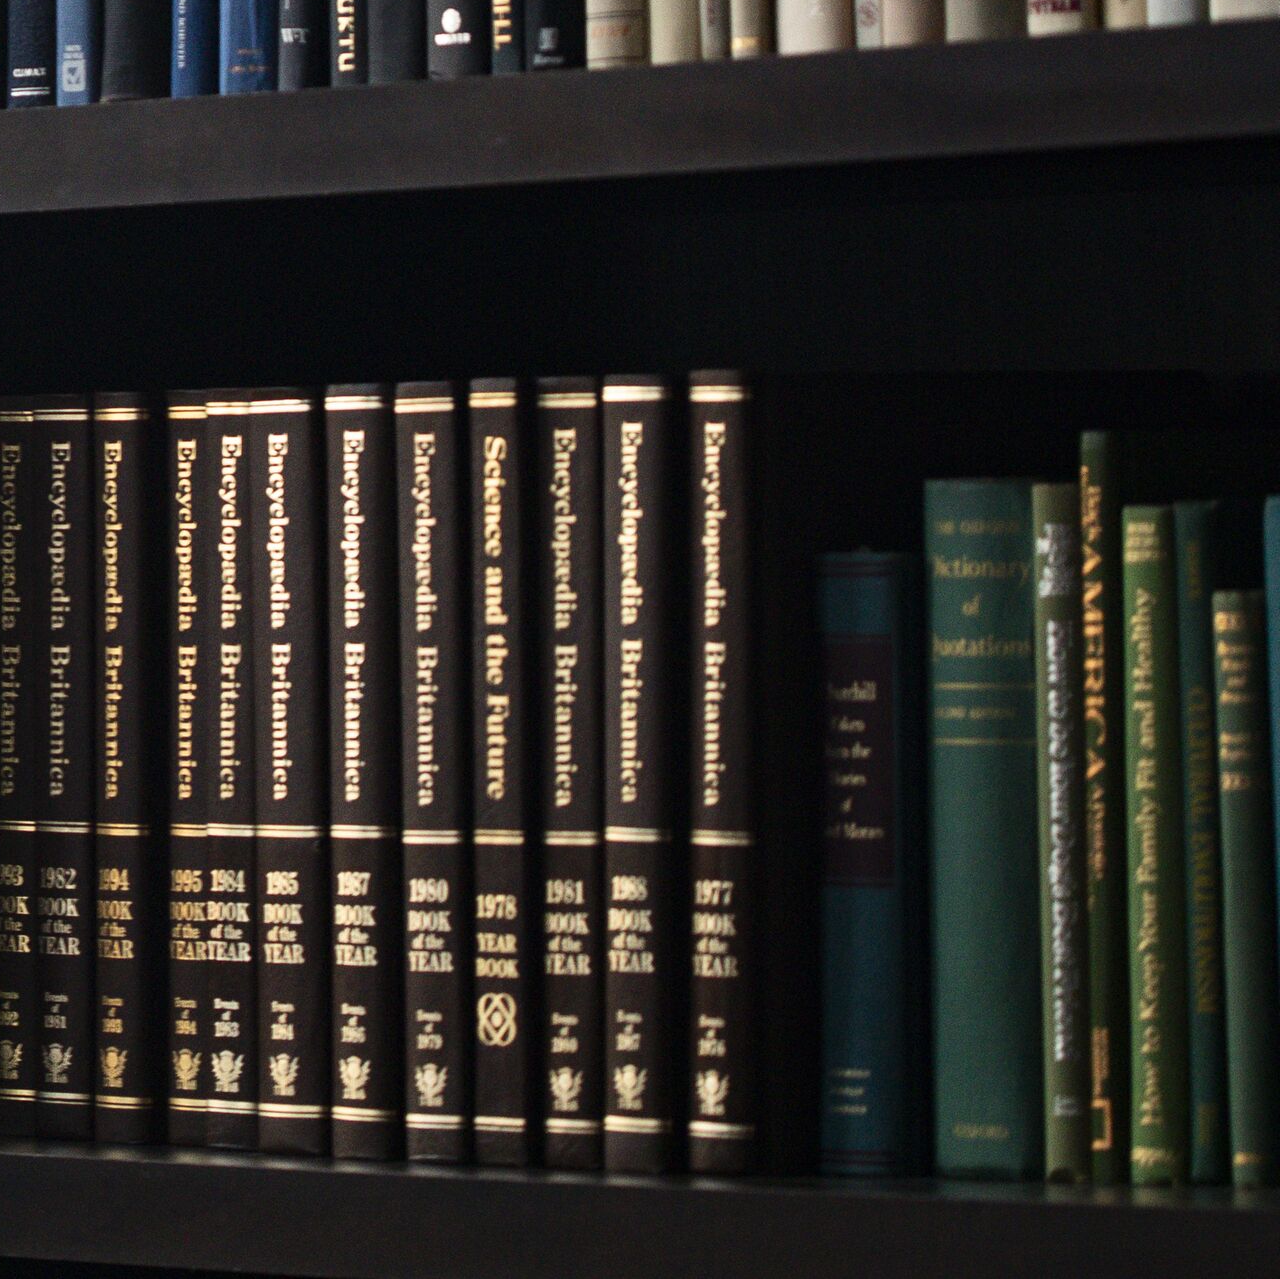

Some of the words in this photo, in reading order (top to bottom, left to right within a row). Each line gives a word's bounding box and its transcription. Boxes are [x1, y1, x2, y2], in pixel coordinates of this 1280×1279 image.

[0, 444, 22, 630] Encyclopædia
[175, 439, 197, 632] Encyclopædia
[266, 433, 289, 629] Encyclopædia
[411, 432, 436, 631] Encyclopædia
[485, 436, 507, 556] Science
[617, 421, 643, 624] Encyclopædia
[701, 421, 726, 626] Encyclopædia
[486, 566, 508, 624] and
[486, 634, 508, 684] the
[0, 644, 21, 796] Britannica
[177, 645, 198, 800] Britannica
[271, 643, 292, 800] Britannica
[416, 646, 439, 806] Britannica
[487, 694, 510, 799] Future
[620, 640, 643, 803] Britannica
[703, 642, 726, 806] Britannica
[477, 934, 517, 953] YEAR
